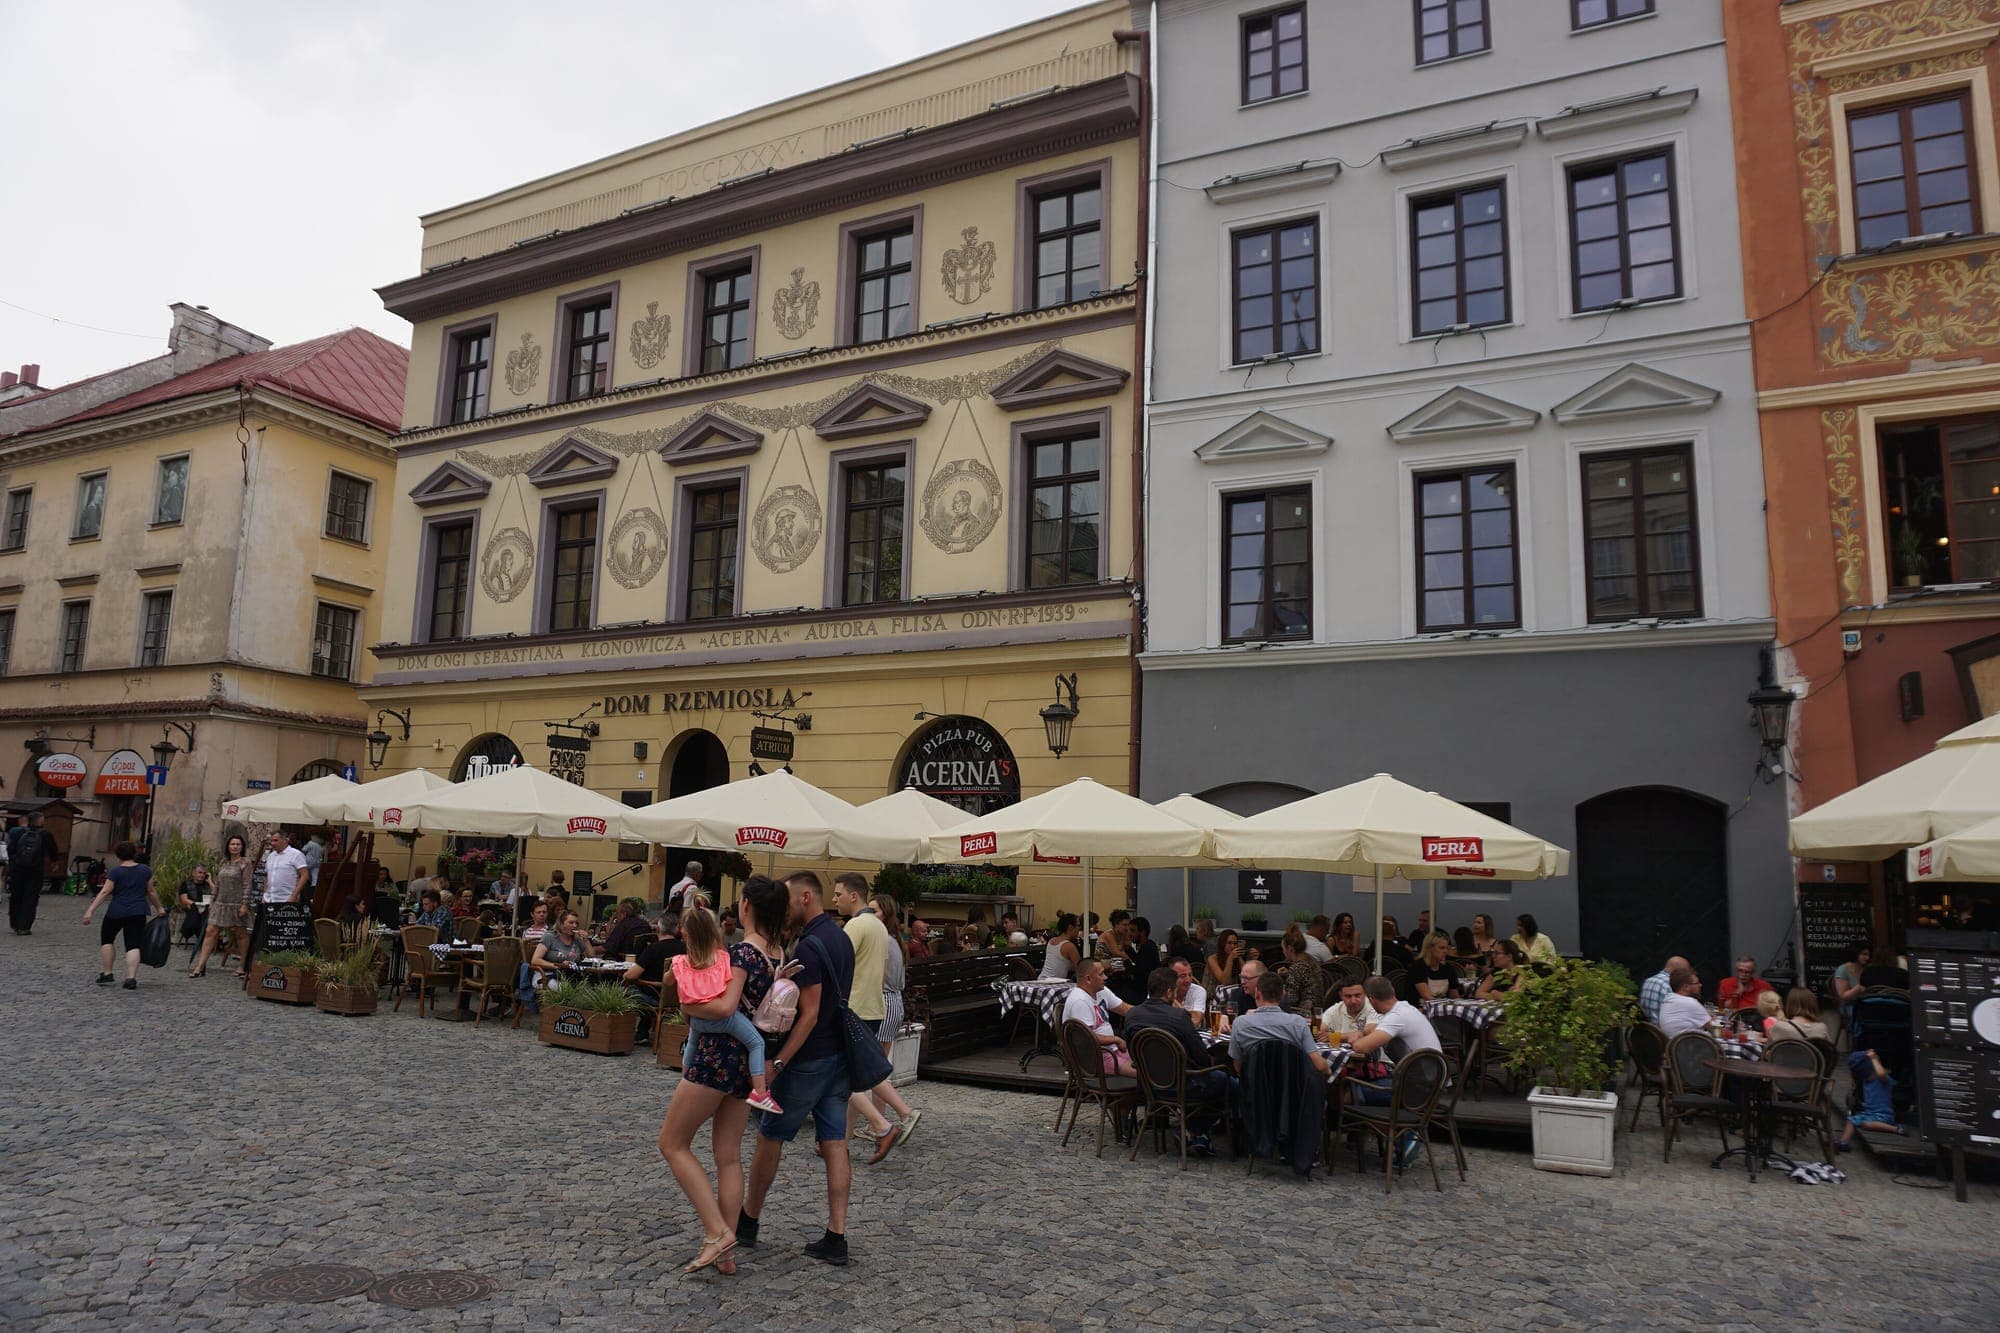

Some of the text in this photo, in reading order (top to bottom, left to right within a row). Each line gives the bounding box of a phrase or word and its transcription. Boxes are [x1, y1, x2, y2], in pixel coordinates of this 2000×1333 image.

[398, 654, 428, 671] DOM
[434, 653, 467, 669] ONGI
[473, 646, 564, 666] SEBASTIANA
[581, 636, 687, 659] KLONOWICZA
[804, 619, 878, 641] AUTORA
[891, 614, 947, 633] FLISA
[604, 695, 650, 714] DOM
[756, 740, 790, 754] ATRIUM
[923, 728, 993, 754] PIZZA PUB
[122, 762, 136, 771] DOZ
[47, 773, 77, 782] APTEKA
[104, 779, 139, 791] APTEKA
[572, 817, 602, 830] ŻYWIEC
[742, 827, 782, 842] ŻYWIEC
[963, 836, 994, 852] PERŁA
[1427, 842, 1479, 856] PERŁA
[1807, 925, 1868, 933] CUKIERNIA
[1807, 933, 1868, 941] RESTAURACJA
[554, 1022, 585, 1037] ACERNA
